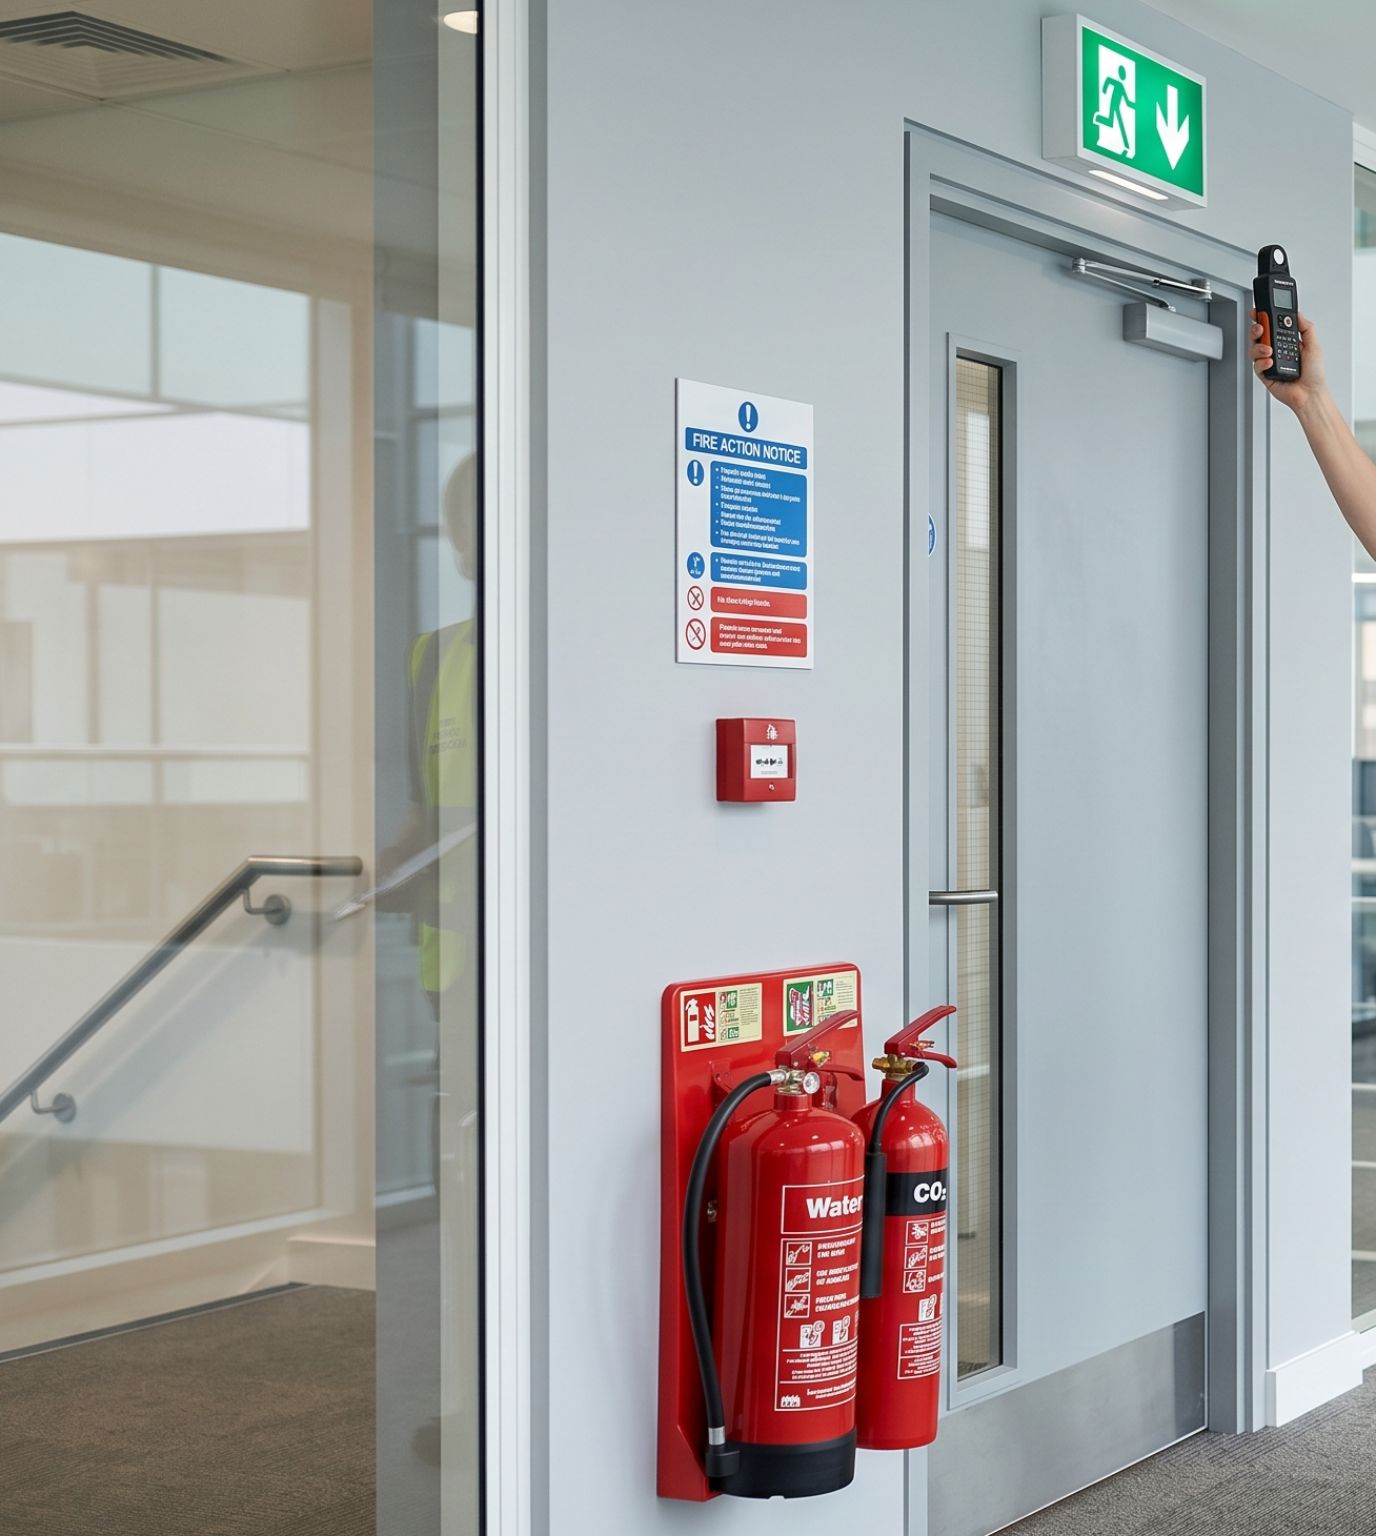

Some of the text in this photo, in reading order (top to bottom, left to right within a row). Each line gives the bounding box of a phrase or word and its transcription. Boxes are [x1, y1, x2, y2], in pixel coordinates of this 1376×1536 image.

[692, 432, 801, 464] FIRE ACTION NOTICE
[806, 1196, 863, 1219] Water
